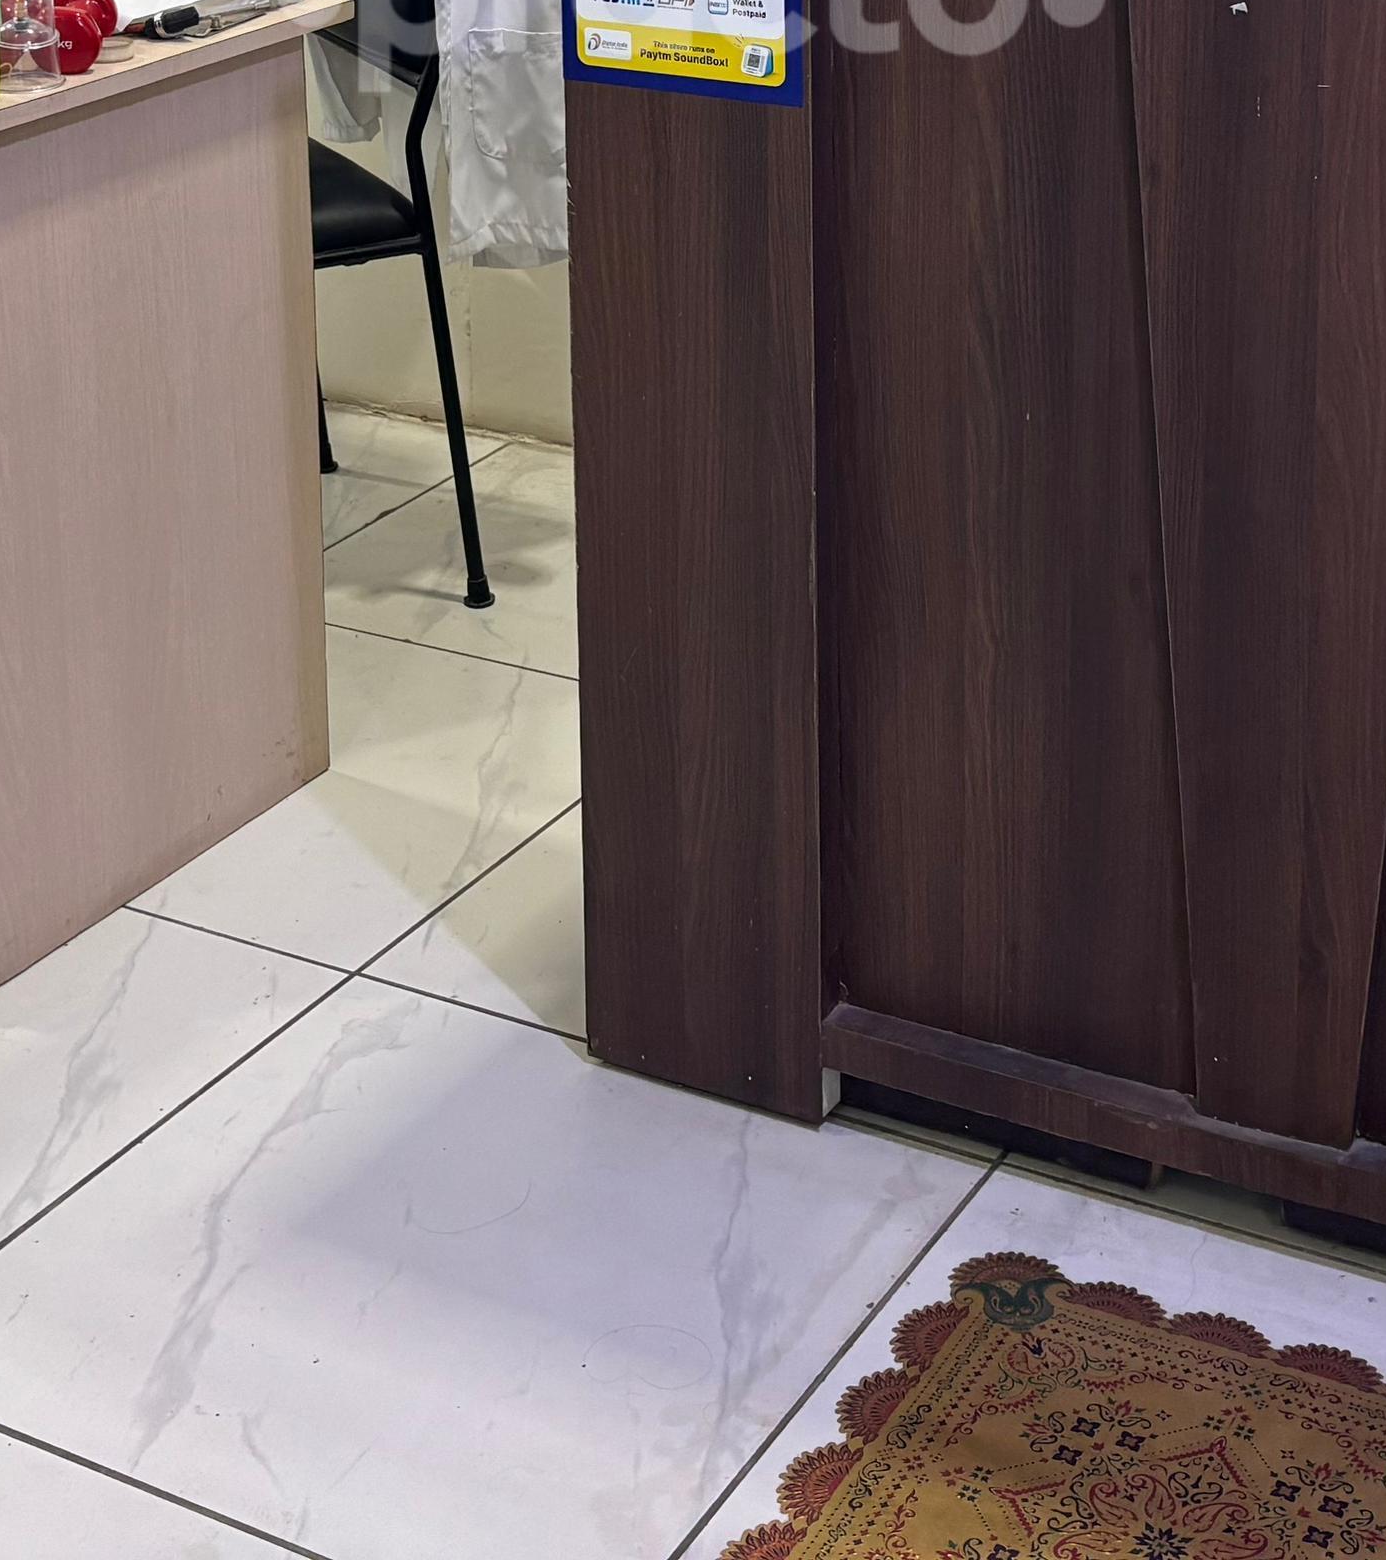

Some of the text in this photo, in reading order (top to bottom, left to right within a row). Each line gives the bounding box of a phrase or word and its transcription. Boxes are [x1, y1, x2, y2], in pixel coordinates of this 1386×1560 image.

[733, 9, 766, 19] Postpaid
[58, 40, 72, 49] kg
[654, 41, 668, 49] This
[670, 43, 688, 51] store
[640, 48, 729, 67] Paytm SoundBox!
